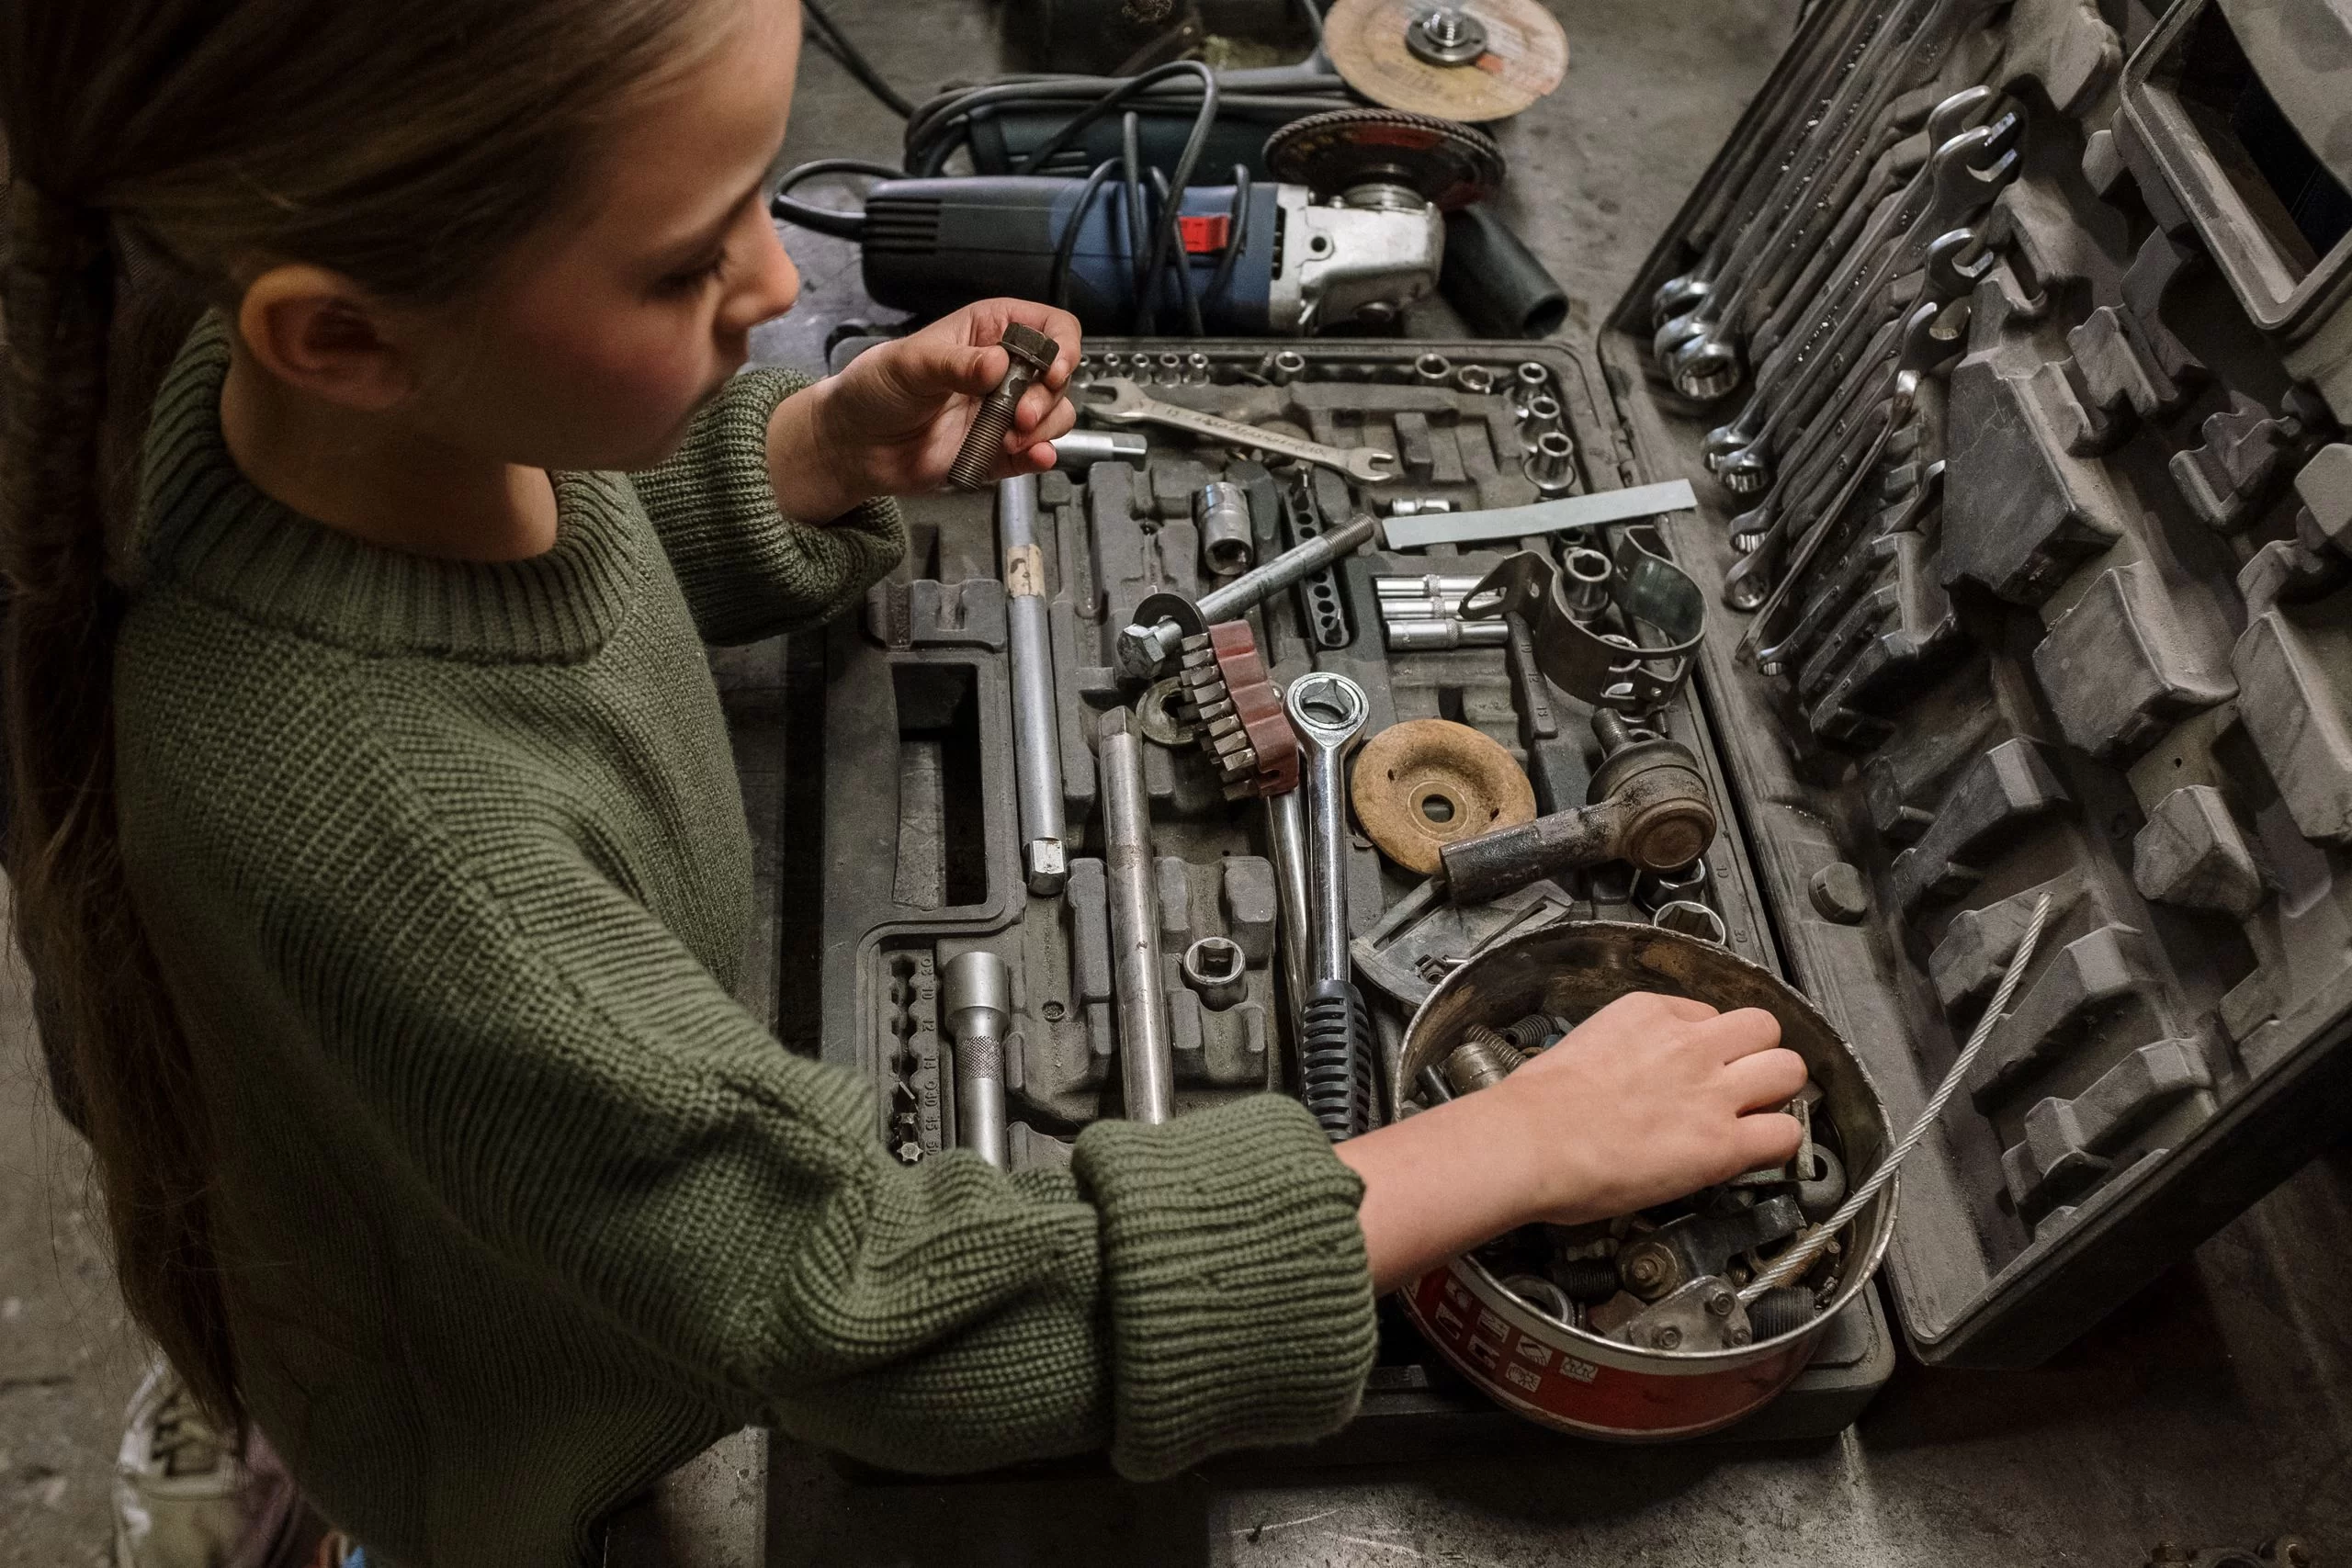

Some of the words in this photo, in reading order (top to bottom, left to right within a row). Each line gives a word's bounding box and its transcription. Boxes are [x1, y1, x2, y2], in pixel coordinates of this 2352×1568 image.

[1528, 673, 1540, 682] 12
[1536, 707, 1549, 716] 13
[922, 988, 934, 1000] 10
[922, 1021, 935, 1032] 12
